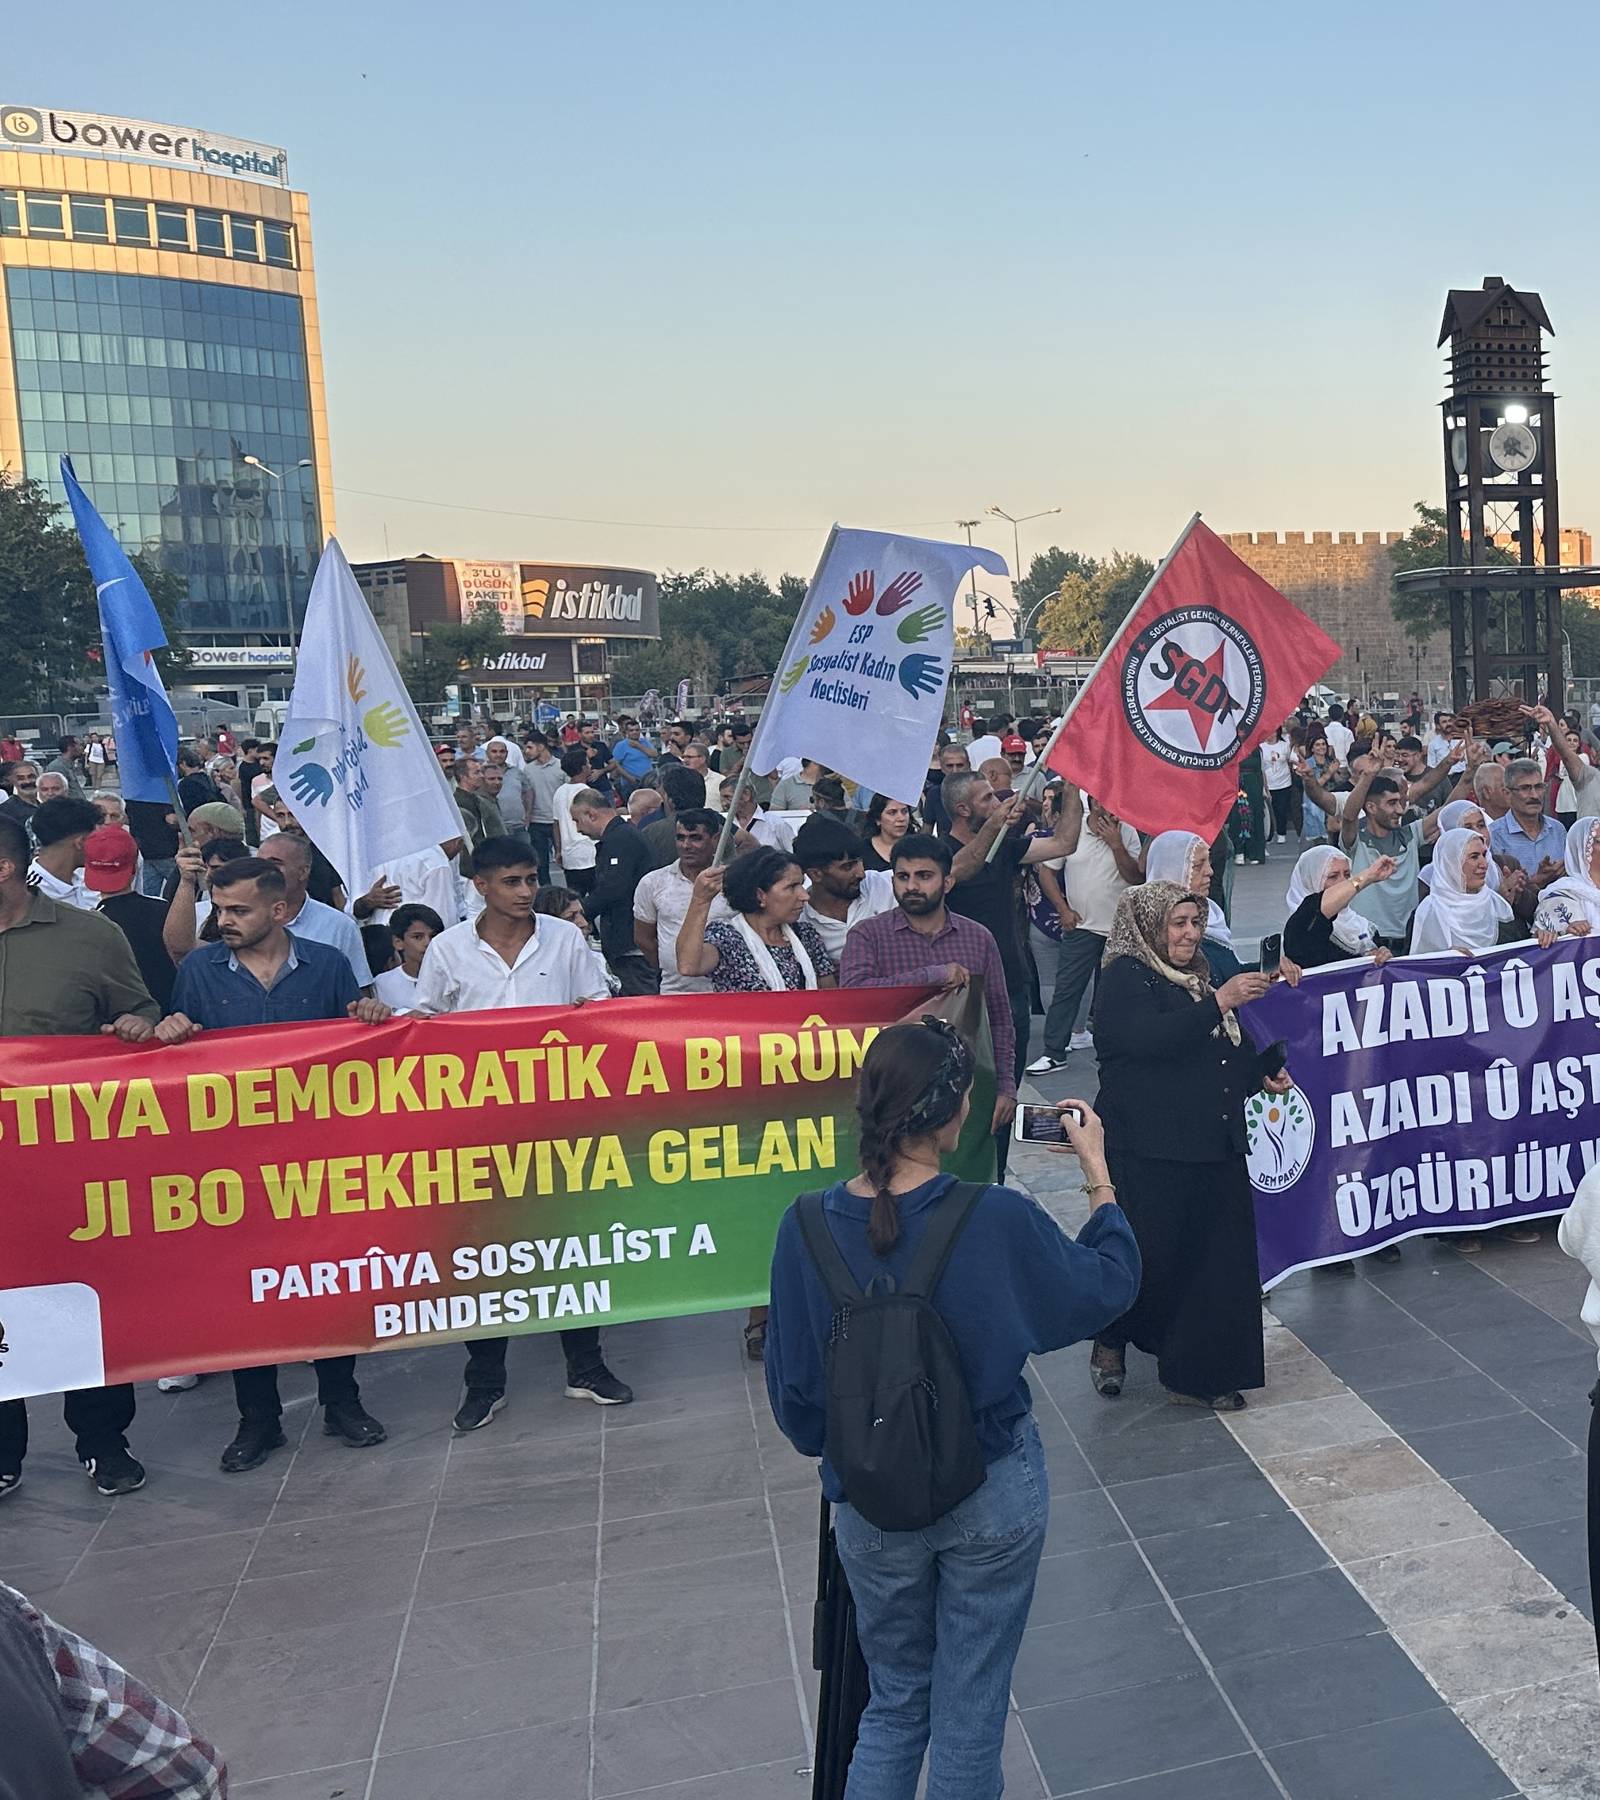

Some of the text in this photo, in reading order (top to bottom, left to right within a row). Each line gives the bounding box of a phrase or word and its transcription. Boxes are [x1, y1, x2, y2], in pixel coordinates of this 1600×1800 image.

[49, 112, 279, 177] bower hospital
[247, 652, 292, 664] hospita
[807, 649, 896, 683] Sosyalist Kadın
[848, 624, 874, 645] ESP
[810, 677, 871, 712] Meclisleri
[1245, 663, 1263, 725] FEDERASYONU
[1322, 964, 1491, 1057] AZADÎ
[1500, 957, 1540, 1030] Û
[187, 1029, 612, 1134] DEMOKRATÎK
[625, 1040, 670, 1096] A
[685, 1035, 743, 1092] BI
[759, 1014, 882, 1086] RÛM
[1330, 1070, 1473, 1149] AZADI
[1484, 1057, 1520, 1121] Û
[68, 1116, 836, 1243] JI BO WEKHEVIYA GELAN
[1258, 1172, 1277, 1187] DEM
[1335, 1137, 1576, 1238] ÖZGÜRLÜK
[251, 1222, 717, 1303] PARTÎYA SOSYALÎST A
[373, 1279, 612, 1339] BINDESTAN
